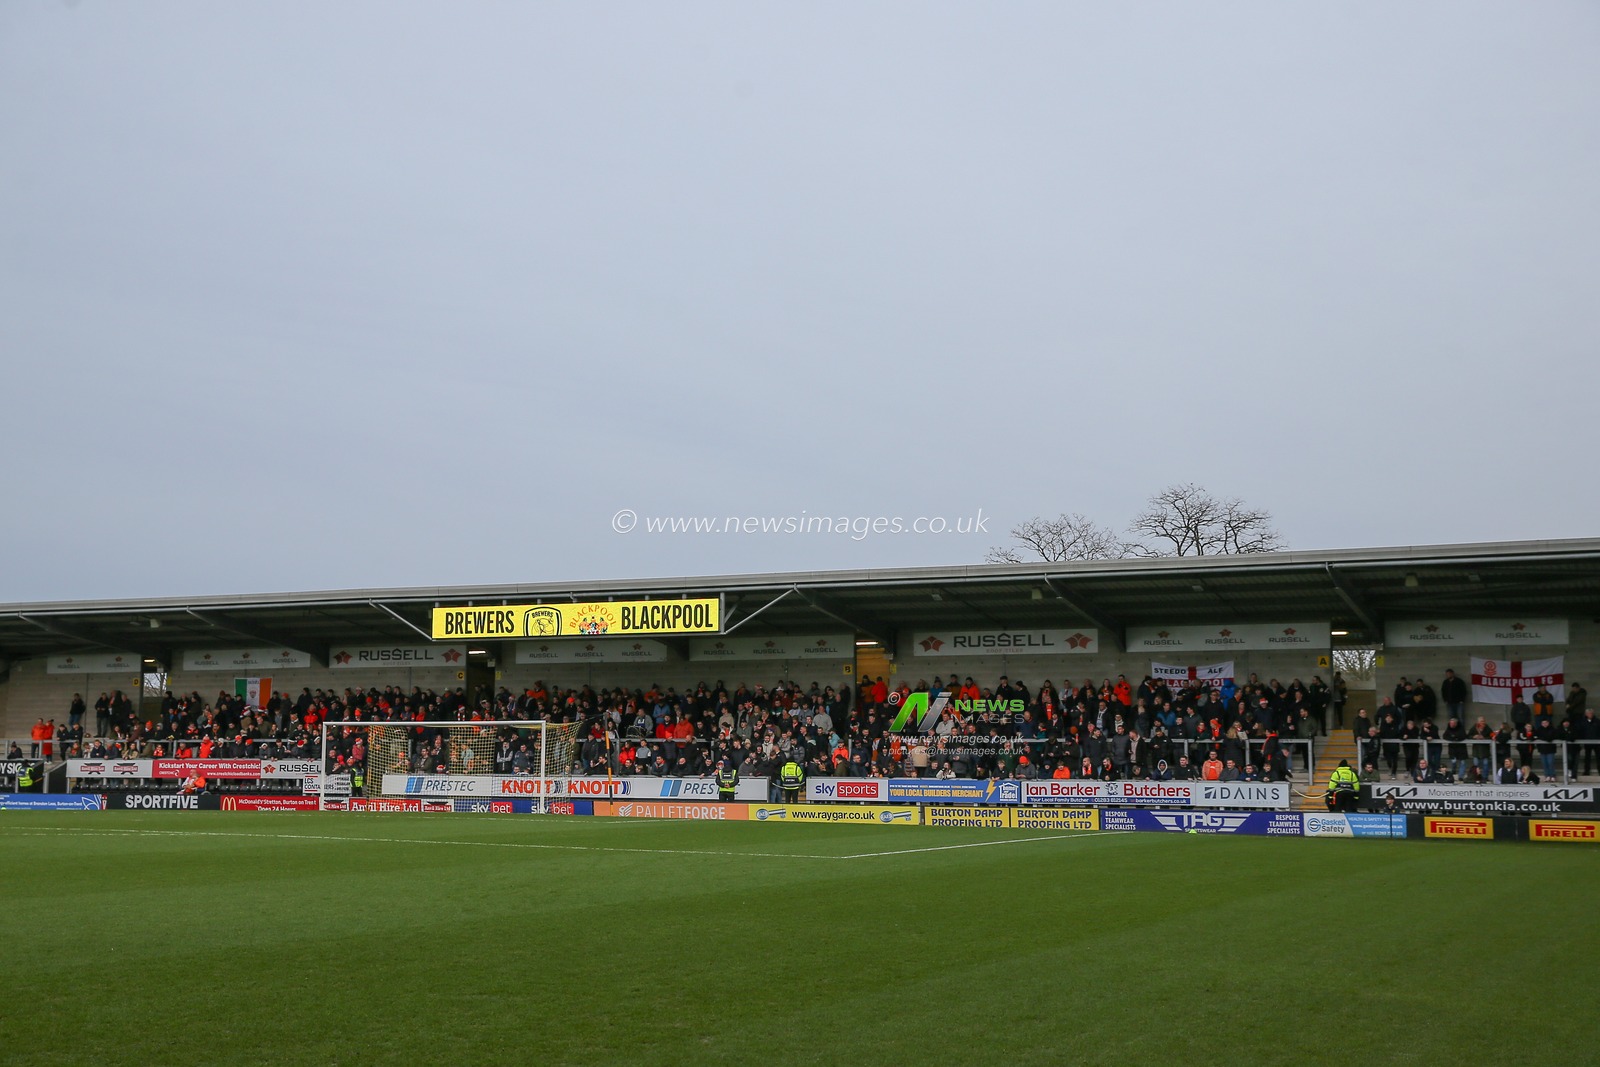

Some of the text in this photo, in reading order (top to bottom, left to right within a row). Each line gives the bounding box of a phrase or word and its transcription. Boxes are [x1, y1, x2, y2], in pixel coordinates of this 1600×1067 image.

[531, 610, 554, 619] BREWERS
[569, 604, 617, 629] BLACKPOOL
[621, 603, 713, 630] BLACKPOOL
[445, 610, 514, 635] BREWERS
[953, 632, 1055, 648] RUSSELL
[1495, 631, 1542, 639] RUSSELL
[359, 648, 434, 661] RUSSELL
[1319, 657, 1327, 666] A
[1154, 667, 1187, 675] STEEDO
[1481, 675, 1554, 687] BLACKPOOL FC
[279, 763, 322, 773] RUSSEL
[425, 779, 476, 792] PRESTEC
[502, 779, 553, 794] KNOTT
[567, 780, 621, 794] KNOTT
[815, 782, 877, 797] sky sports
[1026, 783, 1191, 797] Ian Barker Butchers
[905, 789, 923, 797] LOCAL
[923, 789, 951, 797] BUILDERS
[952, 790, 983, 798] MERCHANT
[1220, 787, 1280, 800] DAINS
[1376, 787, 1417, 797] KIA
[1428, 789, 1472, 797] Movement
[1496, 790, 1530, 798] inspires
[1543, 789, 1588, 800] KIA
[125, 794, 198, 809] SPORTFIVE
[352, 802, 419, 812] Anvil Hire Ltd
[1402, 801, 1561, 812] www.burtonkia.co.uk
[471, 802, 511, 813] sky bet
[553, 803, 572, 815] bet
[636, 805, 725, 820] PALLETFORCE
[931, 808, 1003, 817] BURTON DAMP
[791, 810, 875, 821] www.raygar.co.uk
[1017, 810, 1092, 818] BURTON DAMP
[931, 818, 1003, 827] PROOFING LTD
[1017, 820, 1092, 829] PROOFING LTD
[1269, 820, 1301, 828] TEAMWEAR
[1321, 818, 1346, 826] Gaskell
[1430, 820, 1487, 835] PIRELLI
[1267, 827, 1301, 835] SPECIALISTS
[1535, 823, 1596, 838] PIRELLI
